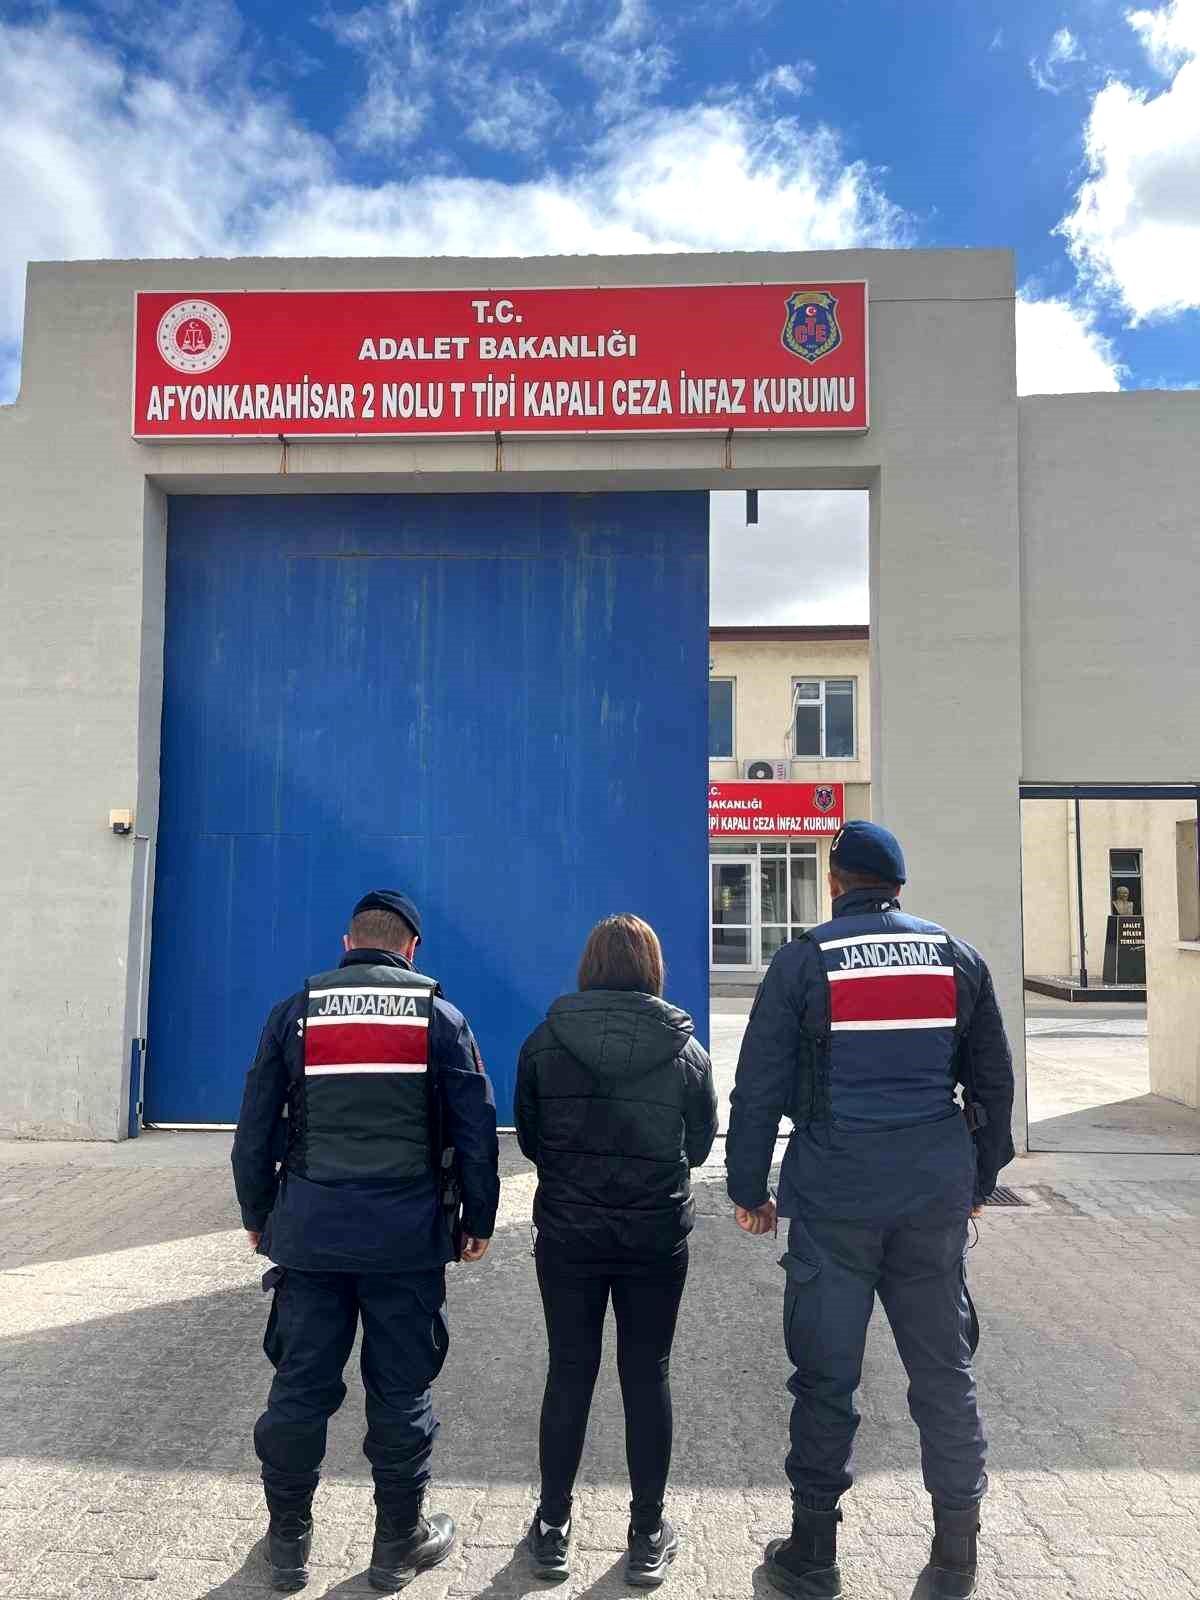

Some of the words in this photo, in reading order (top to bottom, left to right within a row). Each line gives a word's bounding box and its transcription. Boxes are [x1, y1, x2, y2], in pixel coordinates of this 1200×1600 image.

[471, 299, 523, 324] T.C.
[358, 337, 470, 361] ADALET
[479, 328, 637, 360] BAKANLIĞI
[146, 374, 355, 421] AFYONKARAHİSAR
[361, 383, 375, 420] 2
[382, 382, 443, 419] NOLU
[450, 382, 466, 418] T
[472, 373, 515, 418] TİPİ
[523, 380, 604, 417] KAPALI
[611, 379, 673, 416] CEZA
[680, 369, 746, 415] İNFAZ
[753, 376, 856, 414] KURUMU
[708, 786, 721, 796] .C.
[708, 813, 719, 831] İPİ
[721, 816, 751, 831] KAPALI
[752, 816, 775, 831] CEZA
[777, 813, 801, 831] İNFAZ
[803, 816, 841, 831] KURUMU
[839, 942, 942, 970] JANDARMA
[318, 994, 418, 1016] JANDARMA
